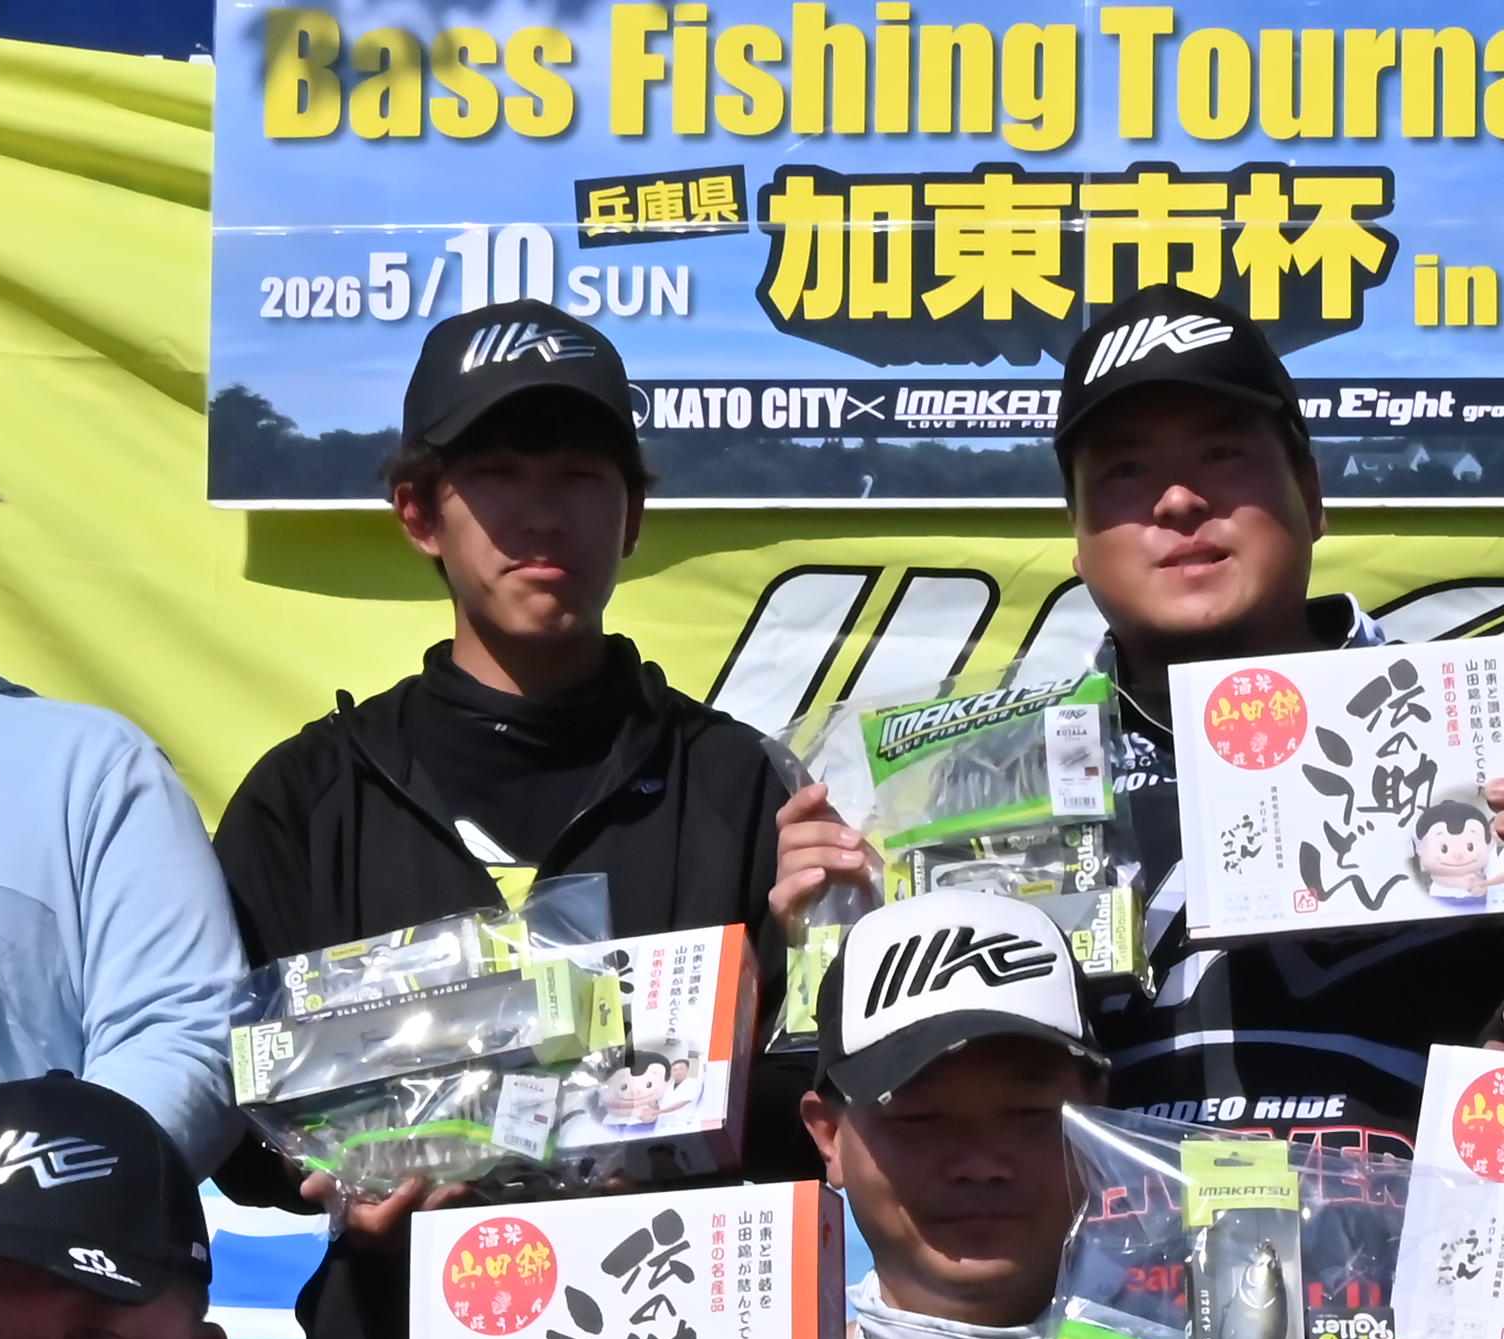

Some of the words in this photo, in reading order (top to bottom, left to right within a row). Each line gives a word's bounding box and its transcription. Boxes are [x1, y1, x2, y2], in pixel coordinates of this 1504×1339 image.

[263, 5, 575, 140] Bass
[611, 2, 1076, 152] Fishing
[586, 176, 739, 237] 兵庫県
[768, 172, 1389, 322] 加東市杯
[1414, 254, 1497, 326] in
[260, 278, 360, 319] 2026
[567, 265, 689, 316] SUN
[653, 389, 752, 430] KATO
[760, 388, 848, 430] CITY
[1338, 389, 1456, 425] Eight
[1254, 1094, 1347, 1119] RIDE
[1198, 1186, 1290, 1198] IMAKATSU
